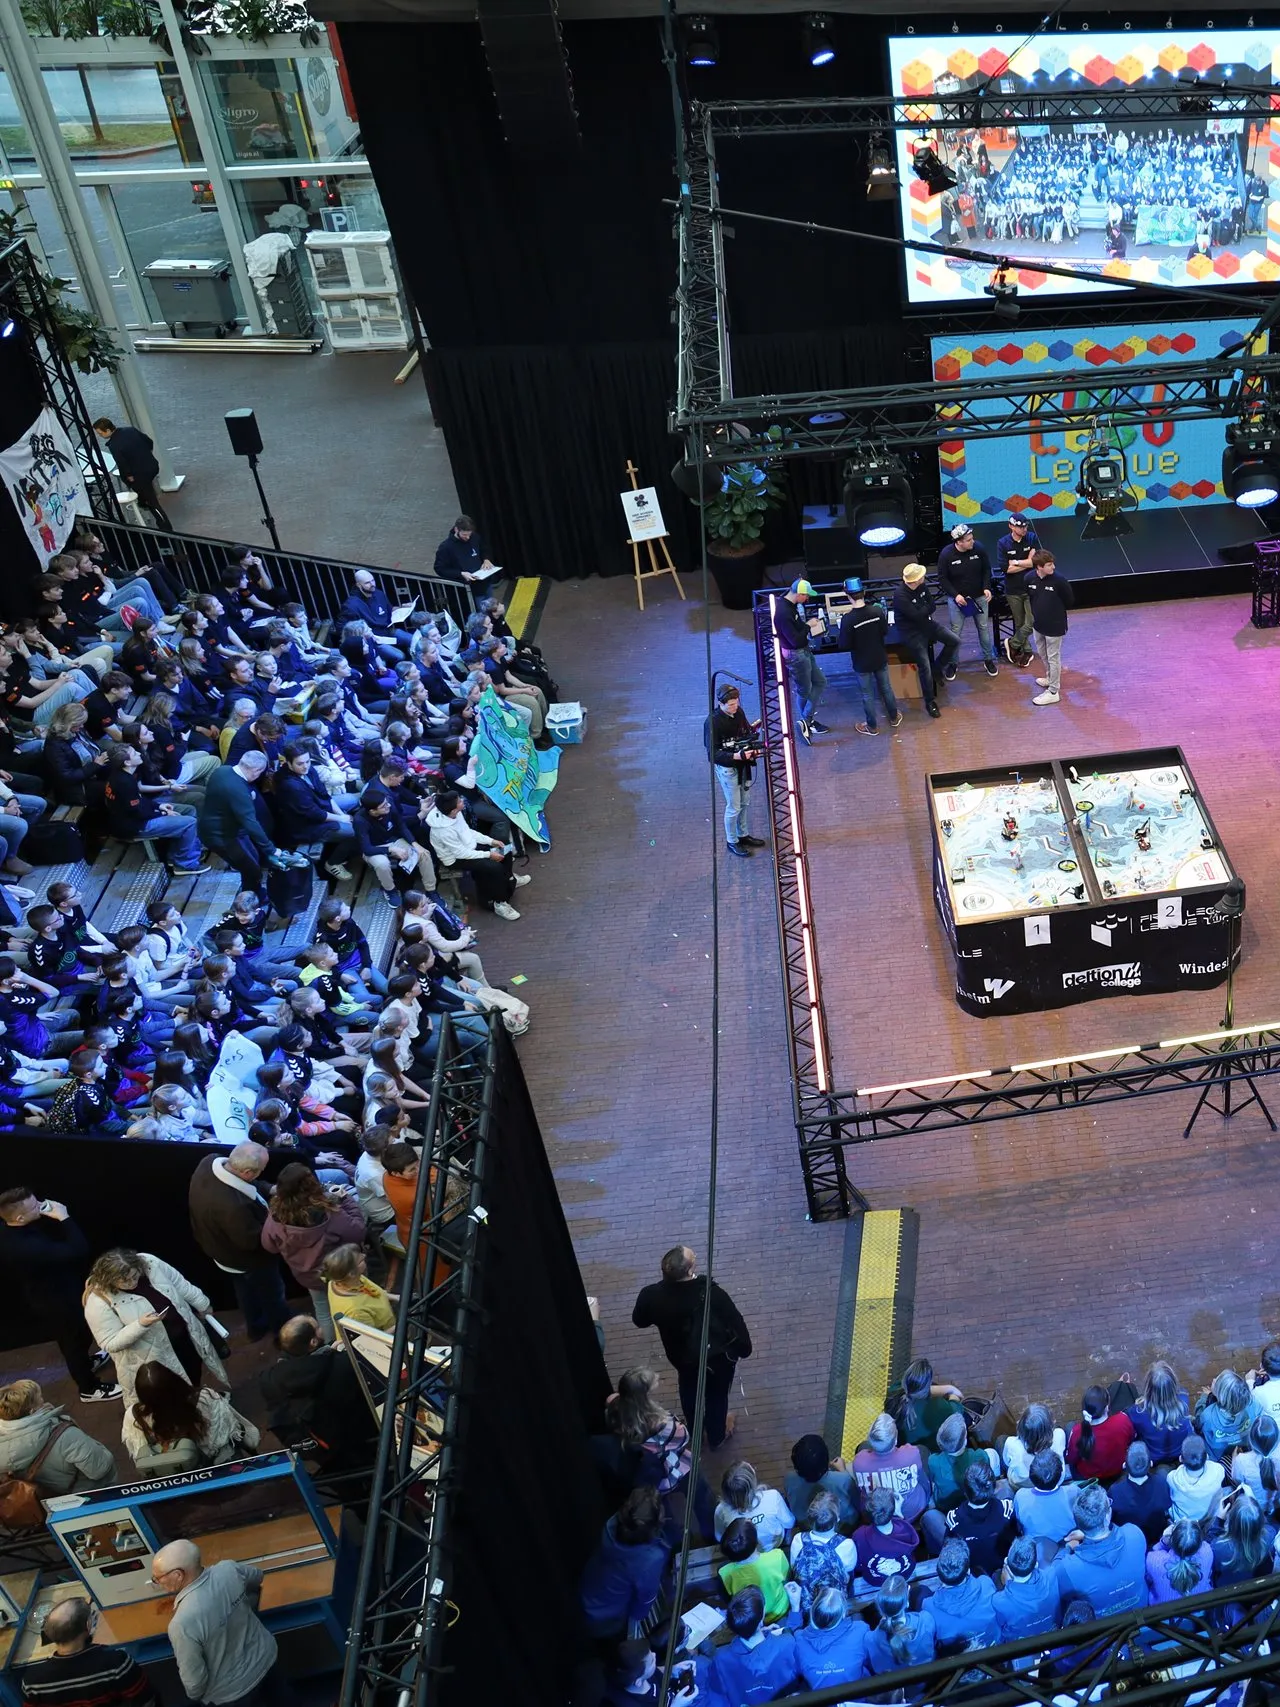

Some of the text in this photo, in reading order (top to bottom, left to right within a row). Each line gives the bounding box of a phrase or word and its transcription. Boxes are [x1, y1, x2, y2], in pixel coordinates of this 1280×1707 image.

[331, 213, 347, 231] P
[1030, 451, 1179, 485] Leue
[1165, 905, 1175, 918] 2
[1033, 924, 1042, 935] 1
[1065, 967, 1123, 987] deltion
[1101, 977, 1142, 988] college
[121, 1470, 214, 1496] DOMOTICA/ICT
